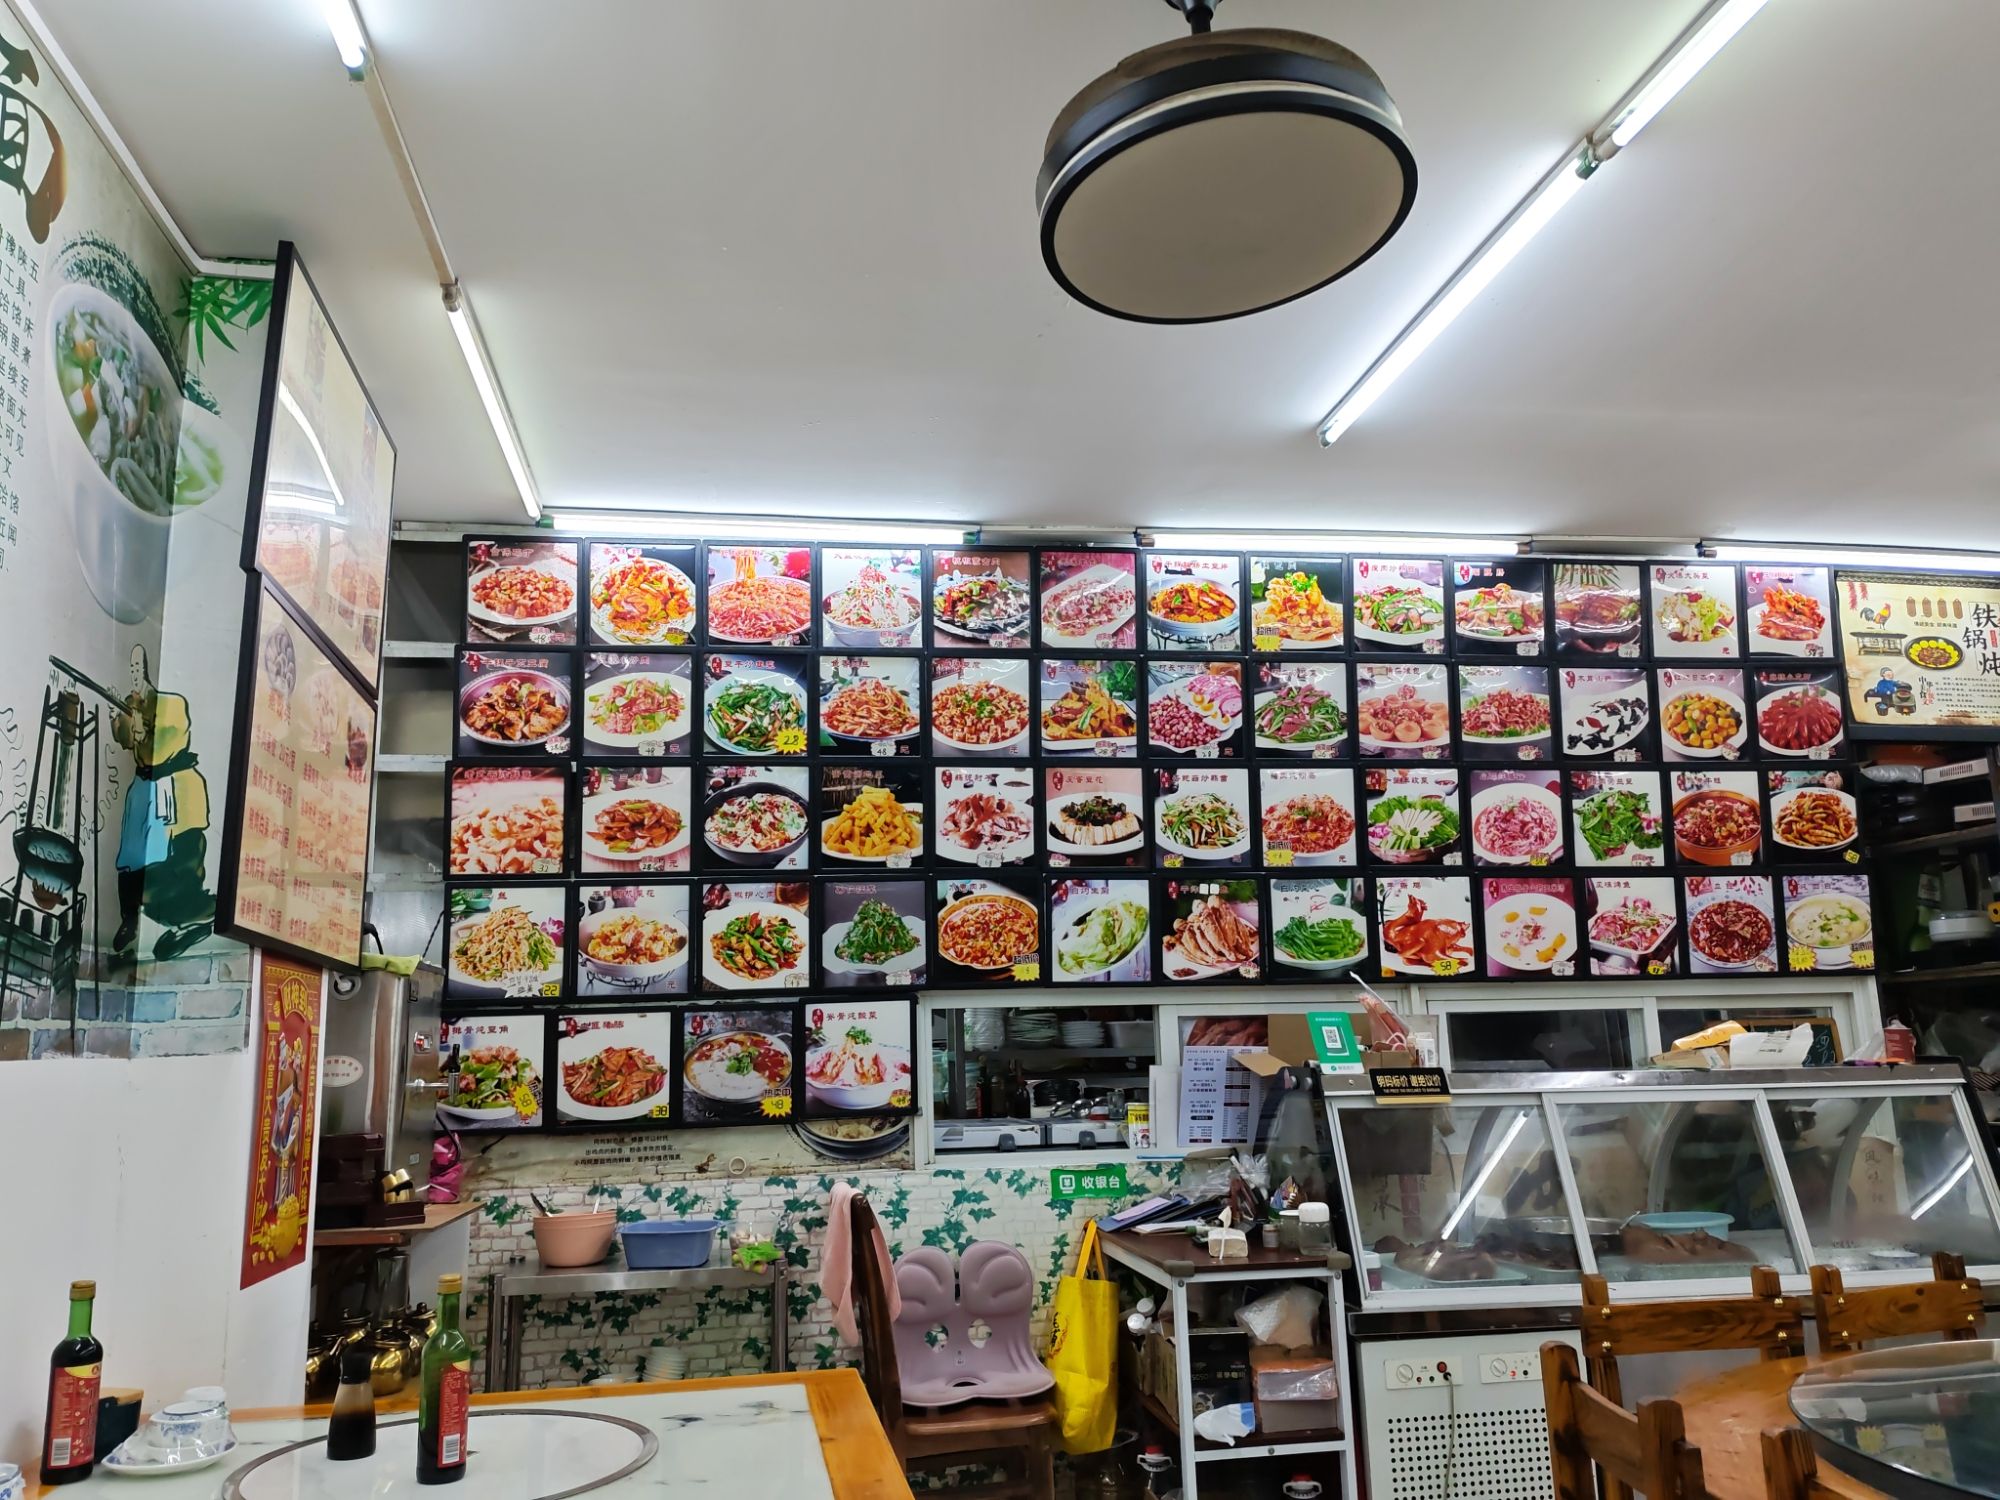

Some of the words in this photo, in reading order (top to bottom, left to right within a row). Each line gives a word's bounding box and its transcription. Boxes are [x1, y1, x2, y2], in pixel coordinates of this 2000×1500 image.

[783, 733, 800, 747] 28
[877, 746, 887, 756] 48
[788, 856, 798, 866] 元
[1846, 853, 1857, 862] 58
[1440, 961, 1452, 973] 58
[543, 983, 558, 997] 22
[281, 980, 309, 1016] 财神到
[452, 1025, 509, 1035] 排骨炖豆角
[1376, 1075, 1408, 1087] 明码标价
[1410, 1074, 1441, 1087] 谢绝议价
[771, 1096, 785, 1110] 48
[655, 1105, 668, 1117] 38
[1082, 1175, 1121, 1190] 收银台
